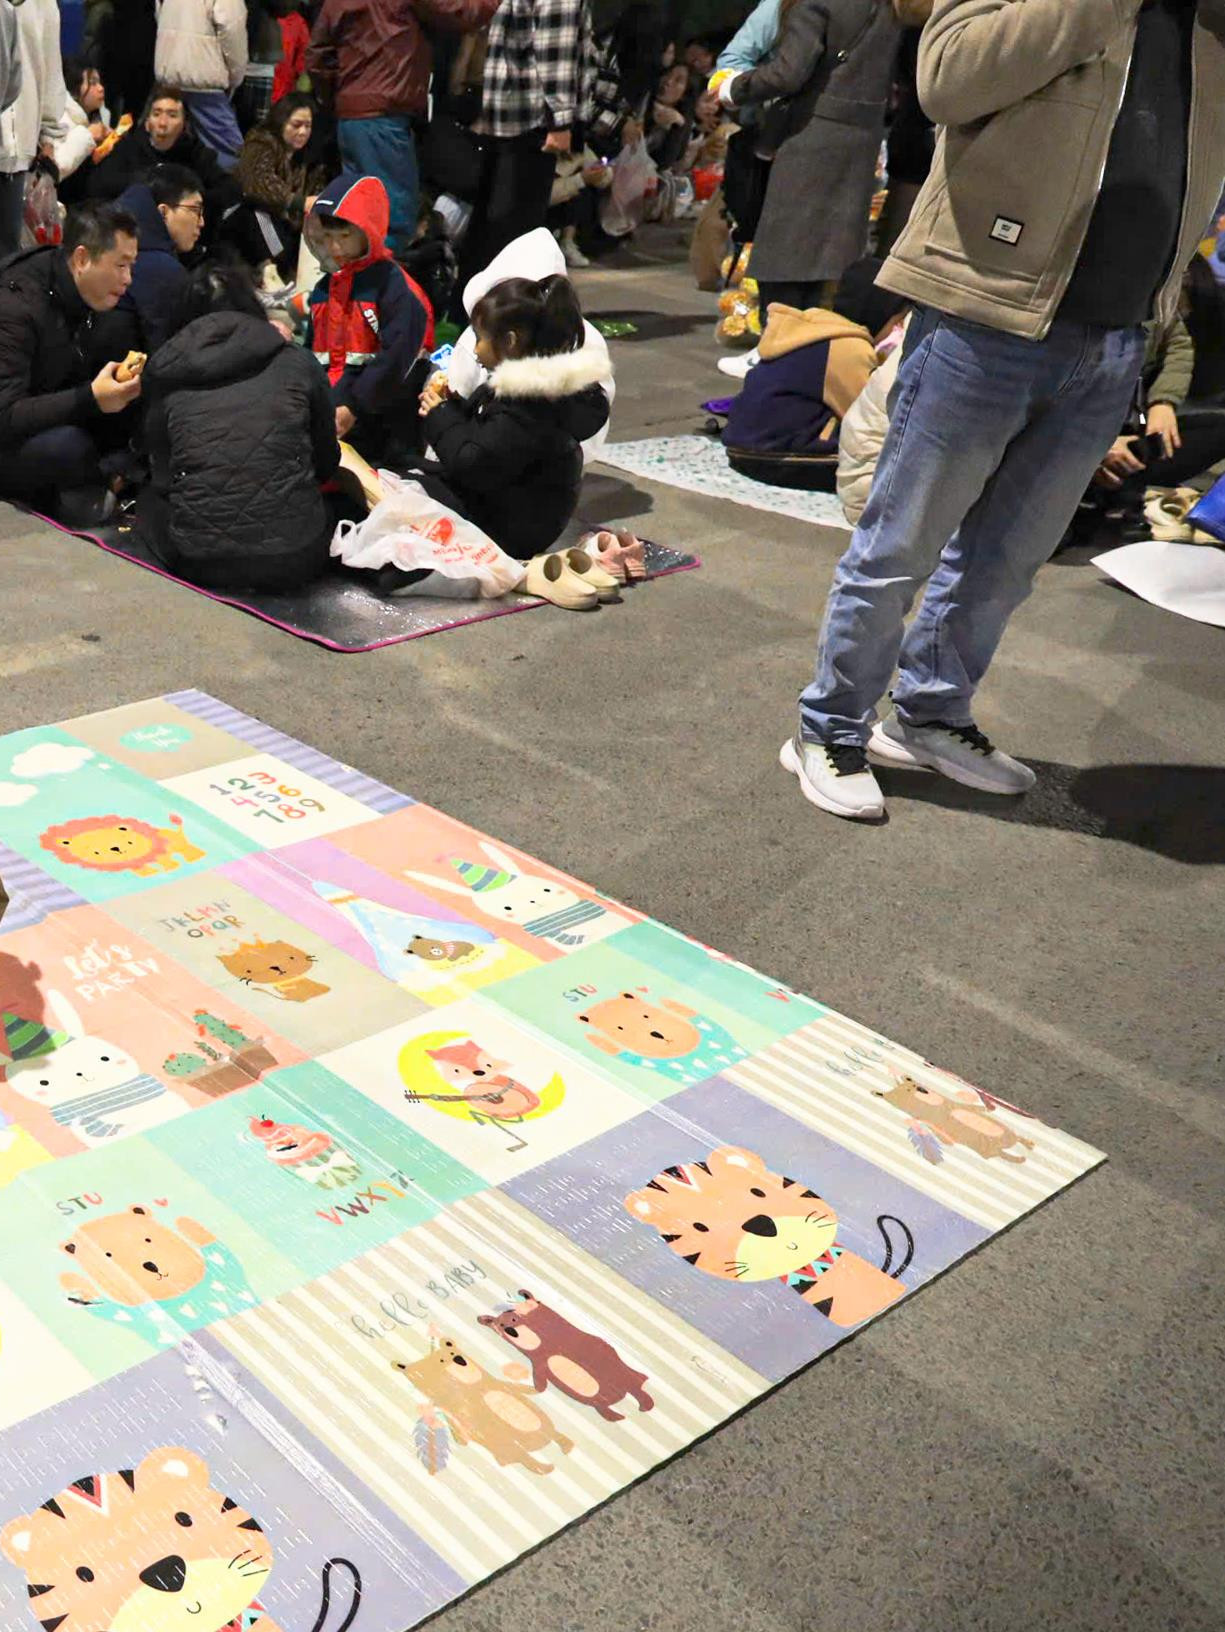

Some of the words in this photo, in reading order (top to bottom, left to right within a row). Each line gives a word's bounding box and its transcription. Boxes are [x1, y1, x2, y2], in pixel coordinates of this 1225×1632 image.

[562, 984, 598, 1002] STU
[55, 1192, 103, 1216] STU
[426, 1259, 487, 1300] BABY
